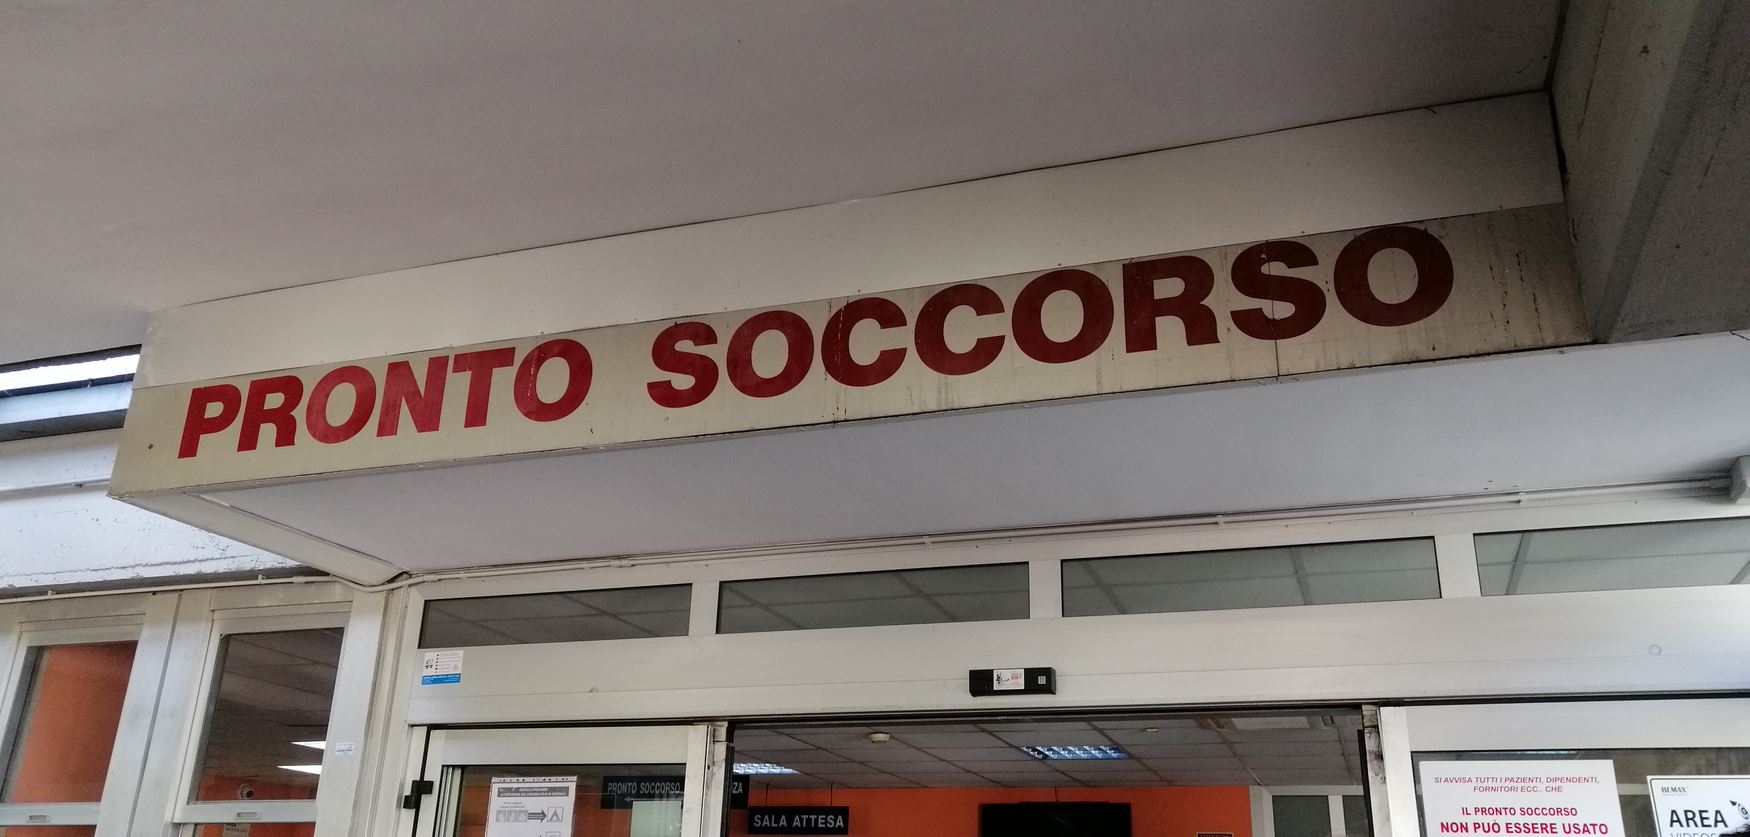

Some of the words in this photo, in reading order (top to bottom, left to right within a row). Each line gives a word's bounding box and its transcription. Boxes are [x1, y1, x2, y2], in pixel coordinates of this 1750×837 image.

[177, 338, 594, 459] PRONTO
[646, 225, 1454, 408] SOCCORSO
[1434, 776, 1442, 784] SI
[1443, 776, 1473, 784] AVVISA
[1475, 776, 1498, 784] TUTTI
[1504, 776, 1544, 784] PAZIENTI,
[1546, 776, 1600, 784] DIPENDENTI,
[607, 782, 637, 794] PRONTO
[639, 782, 681, 794] SOCCORSO
[1473, 785, 1519, 793] FORNITORI
[1545, 785, 1563, 793] CHE
[1461, 807, 1471, 816] IL
[1474, 807, 1516, 816] PRONTO
[1519, 807, 1578, 816] SOCCORSO
[753, 813, 788, 828] SALA
[792, 813, 844, 828] ATTESA
[1669, 809, 1729, 828] AREA
[1440, 821, 1469, 833] NON
[1473, 819, 1501, 834] PUÒ
[1505, 822, 1558, 834] ESSERE
[1562, 822, 1609, 835] USATO
